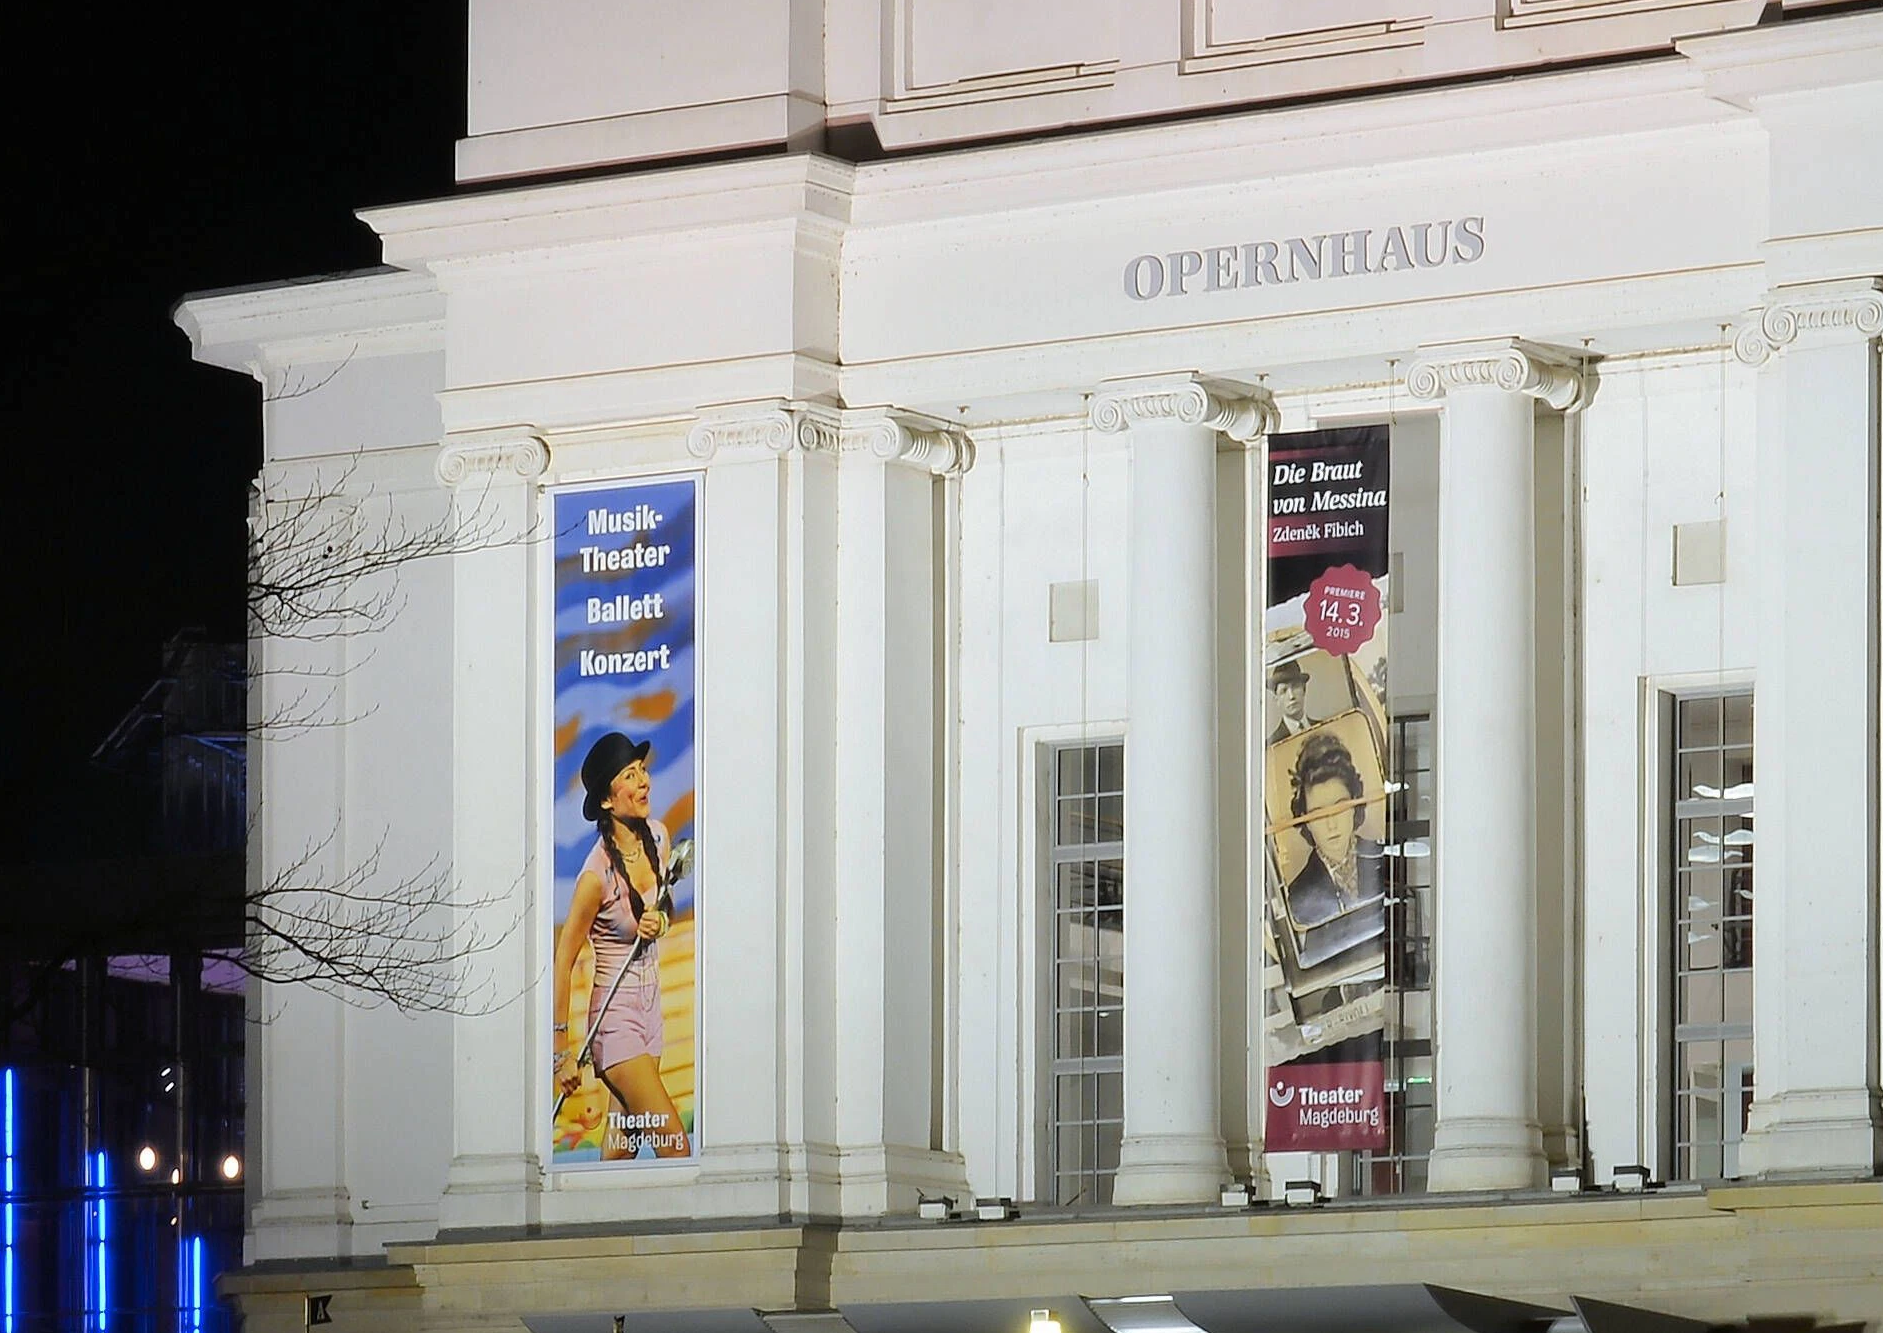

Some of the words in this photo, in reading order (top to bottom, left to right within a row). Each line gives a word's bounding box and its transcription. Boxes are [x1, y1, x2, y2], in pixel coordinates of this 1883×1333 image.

[1123, 215, 1486, 302] OPERNHAUS
[1273, 462, 1306, 486] Die
[1310, 459, 1364, 483] Braut
[1272, 497, 1306, 515] von
[1310, 486, 1388, 512] Messina
[587, 504, 664, 535] Musik-
[1324, 520, 1365, 539] Fibich
[579, 542, 671, 573] Theater
[587, 592, 665, 624] Ballett
[1325, 626, 1351, 640] 2015
[579, 643, 671, 677] Konzert
[1298, 1086, 1364, 1105] Theater
[607, 1111, 669, 1130] Theater
[1299, 1107, 1380, 1128] Magdeburg
[608, 1131, 685, 1153] Magdeburg
